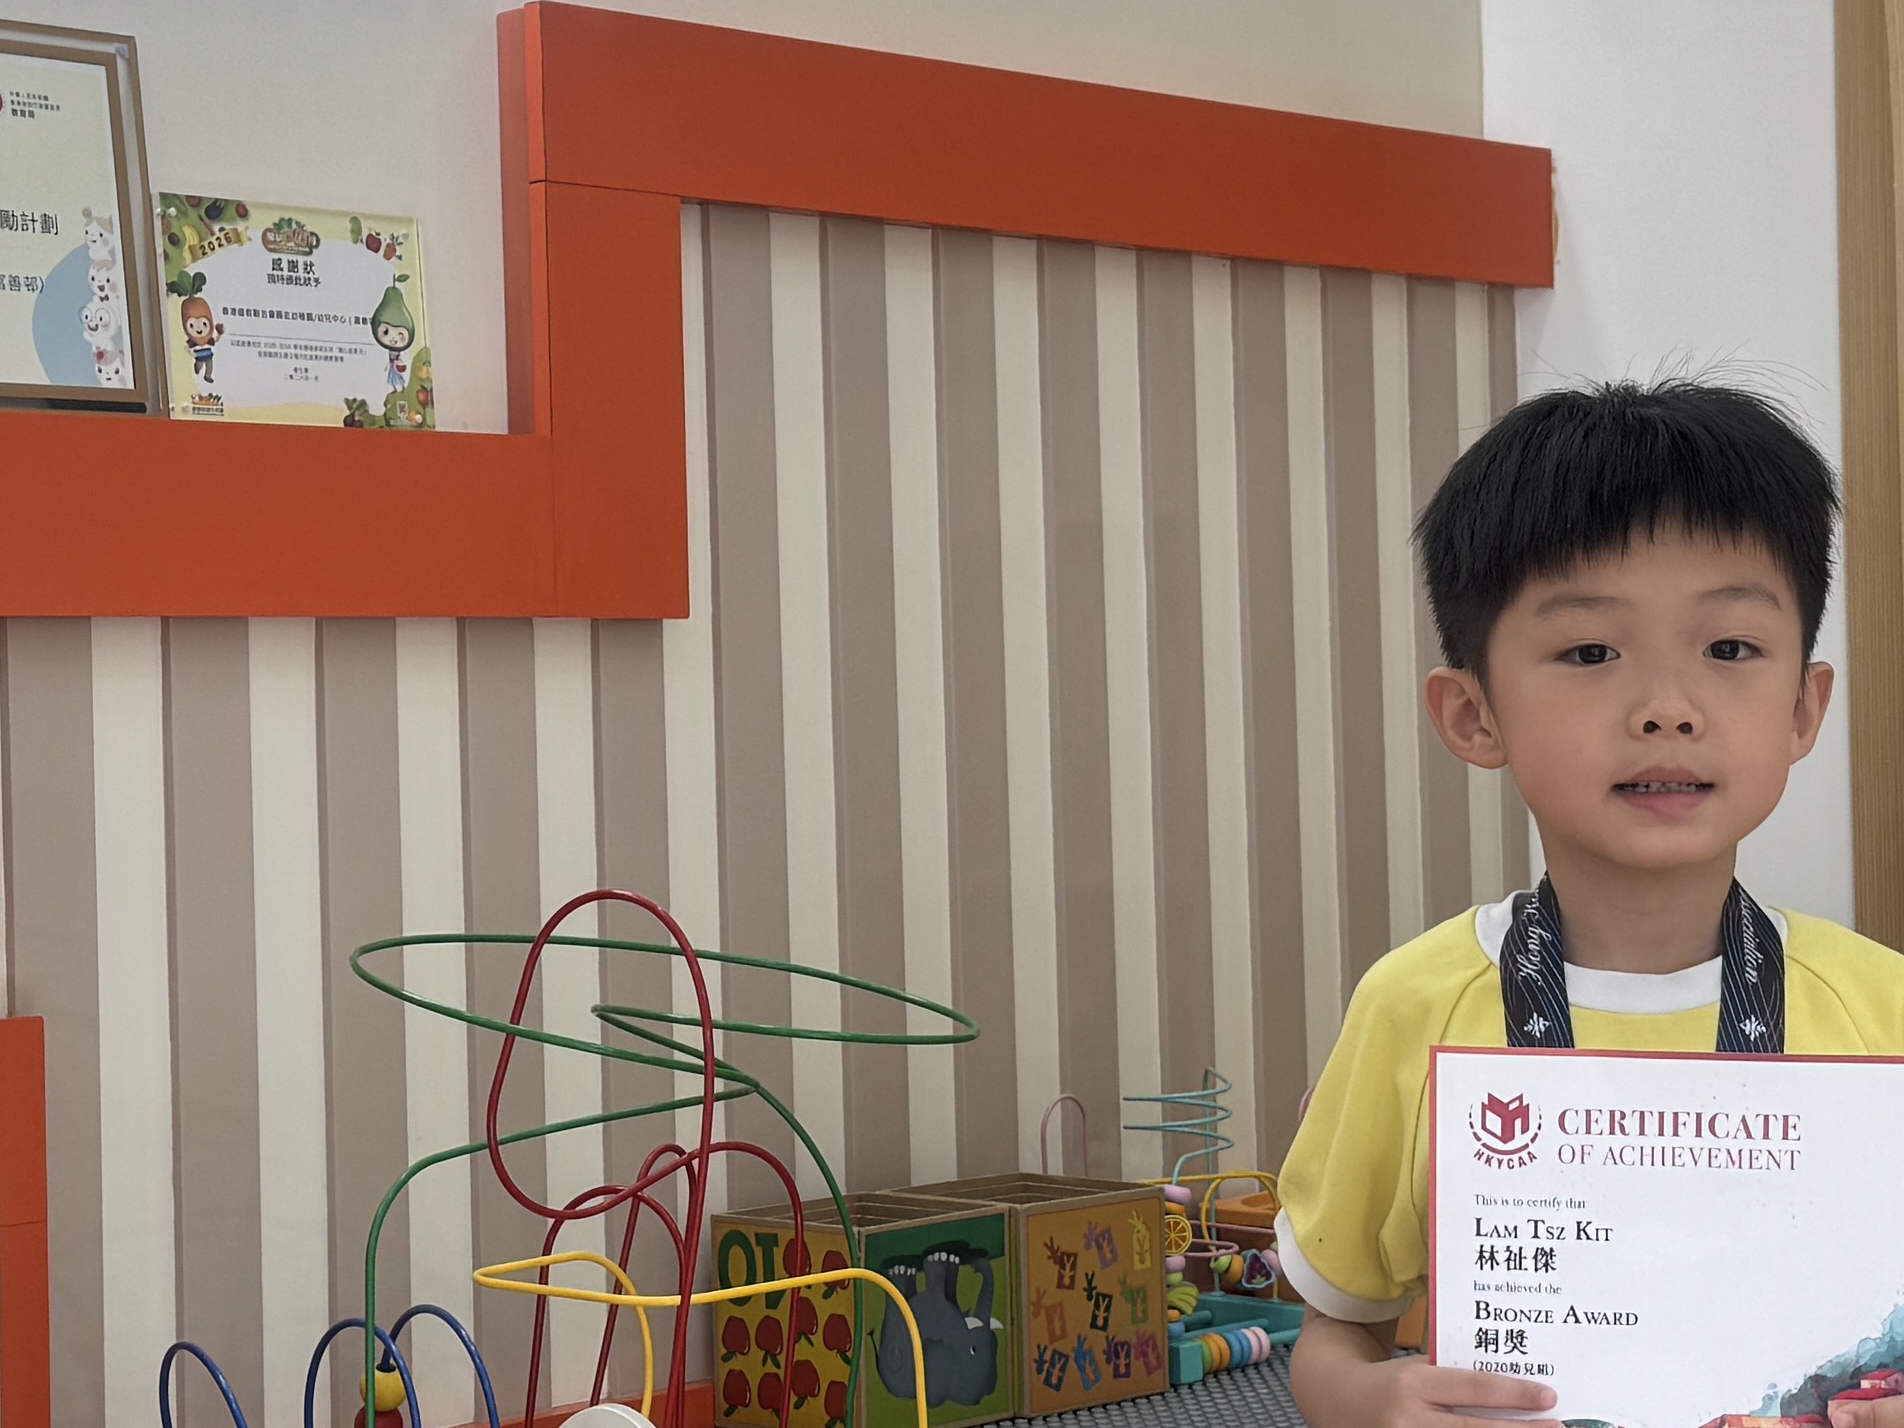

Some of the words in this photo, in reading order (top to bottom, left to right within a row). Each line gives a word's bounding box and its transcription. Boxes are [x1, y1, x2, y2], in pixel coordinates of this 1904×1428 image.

[198, 231, 234, 258] 2026
[1557, 1108, 1802, 1142] CERTIFICATE
[1473, 1147, 1538, 1170] HKYCAA
[1557, 1143, 1594, 1166] OF
[1602, 1144, 1802, 1172] ACHIEVEMENT
